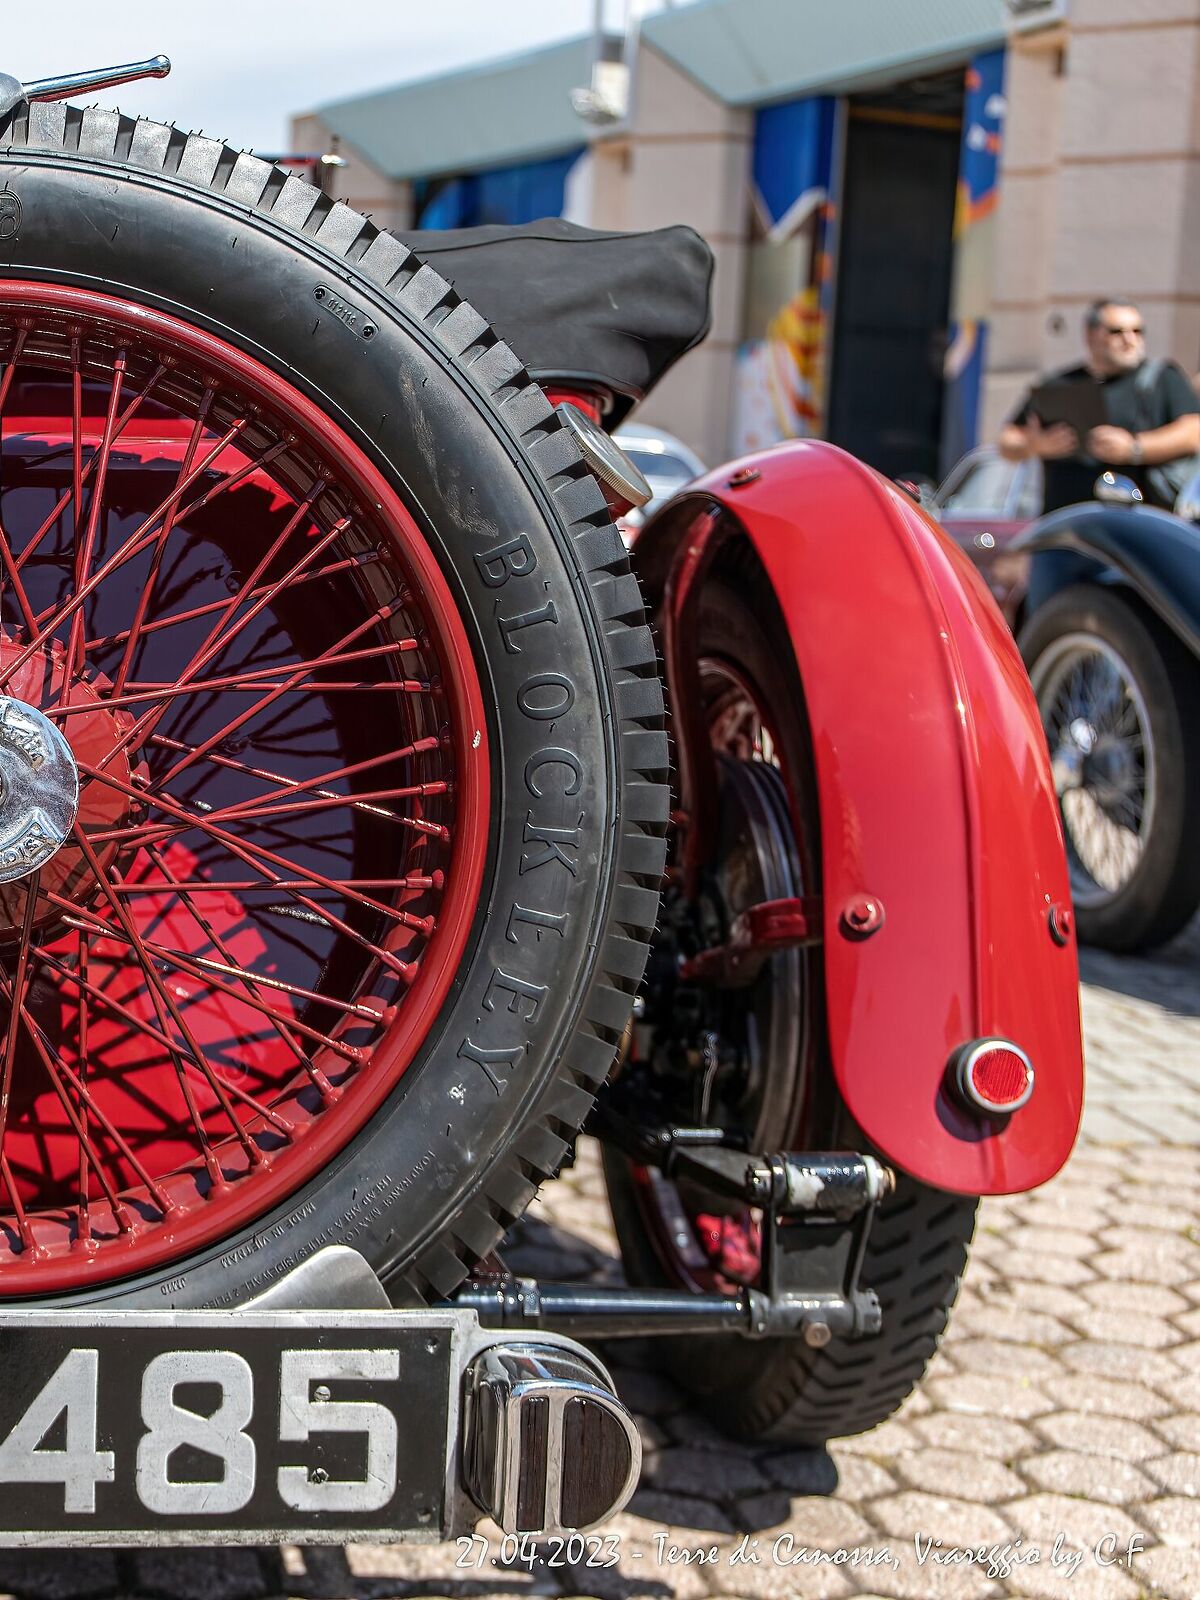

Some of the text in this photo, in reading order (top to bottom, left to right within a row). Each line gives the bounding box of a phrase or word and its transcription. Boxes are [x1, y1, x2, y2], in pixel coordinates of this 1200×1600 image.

[456, 531, 585, 1097] BLOCKLEY
[220, 1201, 317, 1269] MADE IN VIETNAM
